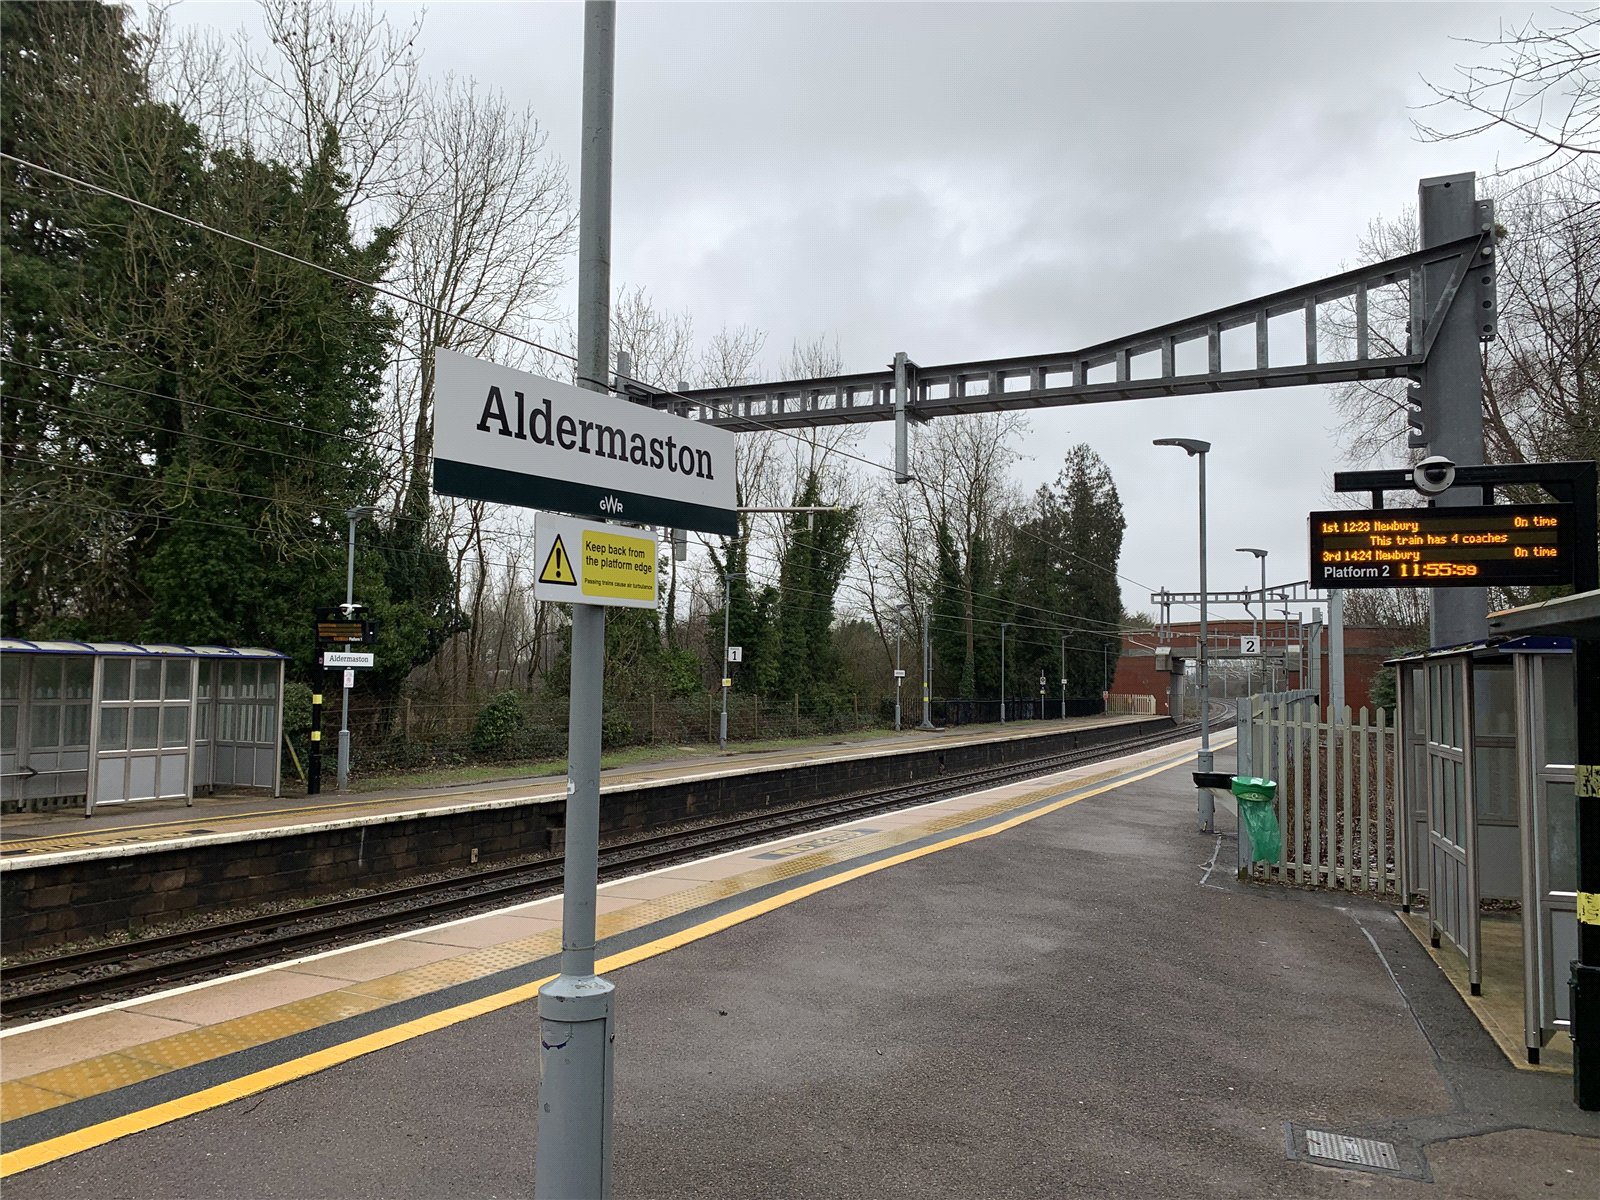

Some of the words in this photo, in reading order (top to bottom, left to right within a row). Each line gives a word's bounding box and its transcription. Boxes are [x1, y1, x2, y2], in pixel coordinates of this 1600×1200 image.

[476, 385, 714, 480] Aldermaston
[599, 495, 624, 514] GWR
[1322, 523, 1340, 533] 1st
[1343, 522, 1370, 533] 12:23
[1374, 520, 1419, 533] Newbury
[1514, 517, 1528, 528] On
[1533, 516, 1557, 527] time
[1370, 535, 1391, 546] This
[1396, 535, 1424, 546] train
[1427, 534, 1446, 545] has
[1451, 534, 1459, 544] 4
[1462, 533, 1508, 544] coaches
[585, 540, 606, 555] Keep
[608, 544, 627, 556] back
[628, 547, 645, 558] from
[1323, 551, 1341, 561] 3rd
[1344, 550, 1372, 561] 14:24
[1375, 549, 1420, 561] Newbury
[1514, 547, 1528, 558] On
[1533, 547, 1557, 557] time
[586, 555, 599, 566] the
[601, 557, 633, 571] platform
[634, 562, 652, 575] edge
[1323, 565, 1378, 579] Platform
[1382, 566, 1390, 577] 2
[1400, 563, 1478, 578] 11:55:59
[584, 578, 601, 586] Passing
[602, 579, 614, 587] trains
[1246, 640, 1255, 652] 2
[329, 655, 369, 663] Aldermaston
[732, 651, 737, 660] 1
